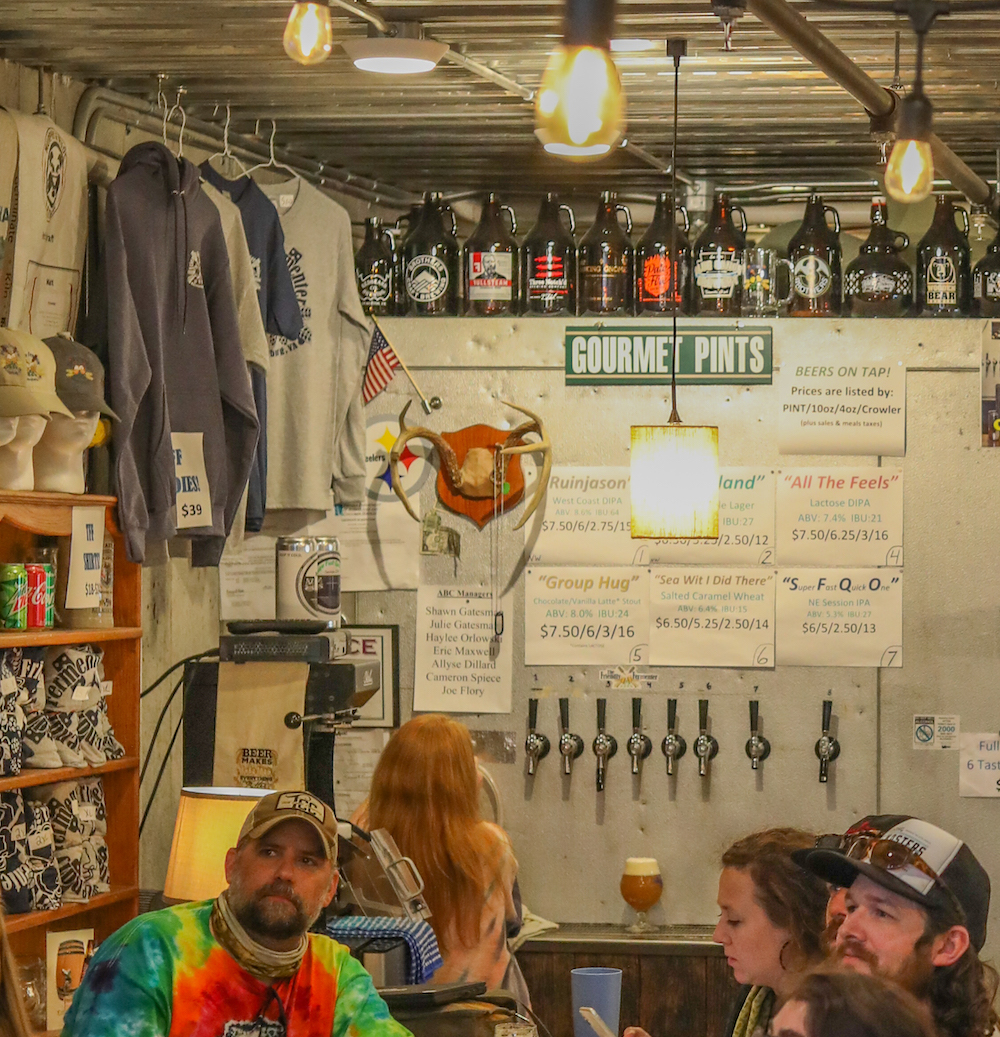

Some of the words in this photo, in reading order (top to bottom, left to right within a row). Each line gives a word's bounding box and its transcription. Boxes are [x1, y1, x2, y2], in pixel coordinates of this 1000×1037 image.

[794, 277, 829, 296] BROTERS
[571, 336, 683, 373] GOURMET
[694, 336, 765, 373] PINTS
[795, 366, 834, 377] BEERS
[837, 367, 857, 377] ON
[862, 367, 891, 378] TAP!
[791, 386, 822, 396] Prices
[825, 388, 842, 396] are
[845, 387, 874, 397] listed
[877, 387, 894, 398] by:
[783, 403, 902, 415] PINT/10oz/4oz/Crowler
[800, 419, 816, 427] (plus
[863, 420, 883, 428] taxes)
[176, 475, 200, 493] DIES!
[549, 475, 631, 492] Ruinjason
[784, 475, 813, 489] “All
[817, 476, 845, 489] The
[849, 475, 899, 489] Feels”
[552, 496, 574, 505] West
[576, 496, 600, 505] Coast
[602, 496, 622, 505] DIPA
[729, 501, 755, 511] Lager
[810, 499, 845, 508] Lactose
[848, 499, 870, 507] DIPA
[181, 504, 202, 518] $39
[722, 517, 754, 526] IBU:27
[798, 514, 820, 523] ABV:
[823, 514, 846, 523] 7.4%
[851, 514, 882, 523] IBU:21
[542, 521, 631, 532] $7.50/6/2.75/15
[792, 529, 889, 542] $7.50/6.25/3/16
[761, 550, 772, 565] 2
[889, 549, 900, 565] 4
[538, 575, 593, 593] “Group
[598, 575, 640, 593] Hug”
[655, 574, 680, 585] “Sea
[683, 575, 703, 585] Wit
[712, 575, 731, 585] Did
[735, 575, 773, 586] There”
[817, 577, 838, 592] Fast
[839, 577, 866, 593] Quick
[437, 589, 454, 598] ABC
[456, 590, 493, 599] Managers
[661, 591, 689, 600] Salted
[692, 591, 731, 601] Caramel
[733, 592, 764, 601] Wheat
[533, 597, 597, 606] Chocolate/Vanilla
[808, 598, 820, 607] NE
[822, 598, 853, 607] Session
[856, 598, 870, 607] IPA
[425, 606, 456, 616] Shawn
[545, 610, 568, 618] ABV:
[570, 610, 593, 618] 8.0%
[598, 610, 629, 618] IBU:24
[697, 605, 717, 613] 6.4%
[806, 610, 824, 618] ABV:
[826, 610, 844, 618] 5.3%
[429, 620, 451, 629] Julie
[655, 617, 769, 630] $6.50/5.25/2.50/14
[802, 621, 876, 634] $6/5/2.50/13
[426, 632, 457, 643] Haylee
[540, 624, 635, 640] $7.50/6/3/16
[433, 646, 452, 655] Eric
[455, 646, 495, 656] Maxwell
[632, 648, 642, 662] 5
[756, 646, 769, 665] 6
[887, 650, 898, 667] 7
[432, 659, 462, 670] Allyse
[464, 660, 496, 669] Dillard
[426, 672, 468, 682] Cameron
[442, 686, 457, 695] Joe
[460, 686, 485, 697] Flory
[979, 740, 1000, 752] Full
[241, 748, 272, 758] BEER
[241, 757, 273, 765] MAKES
[967, 759, 974, 770] 6
